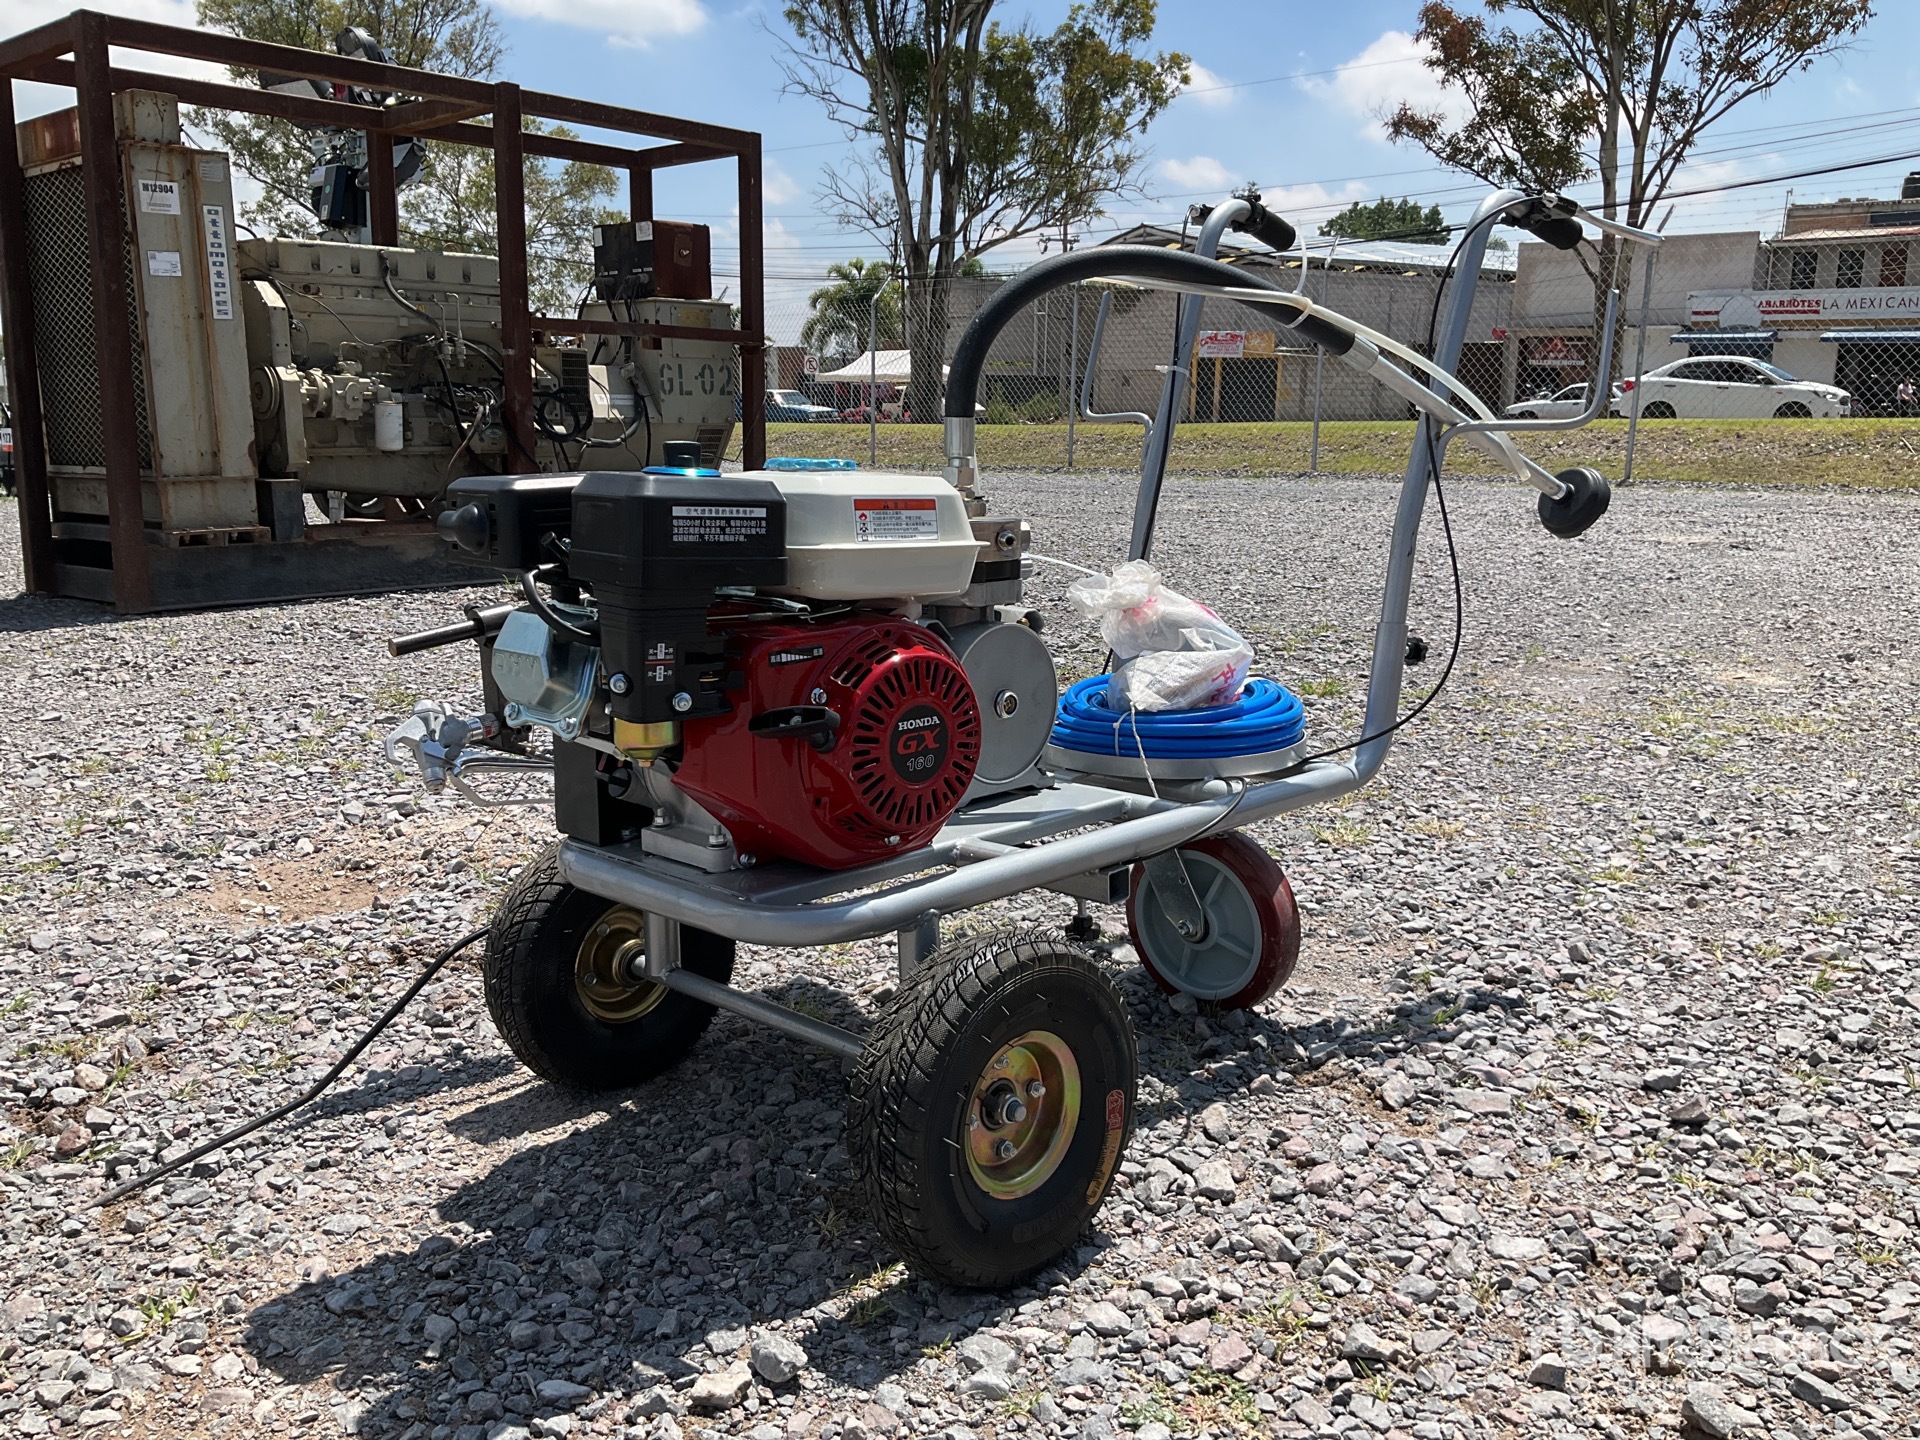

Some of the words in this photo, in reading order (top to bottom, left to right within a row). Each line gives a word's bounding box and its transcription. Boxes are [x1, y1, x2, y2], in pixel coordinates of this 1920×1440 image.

[206, 208, 229, 316] ottomotores
[1822, 298, 1839, 310] LA
[898, 716, 940, 731] HONDA
[898, 728, 940, 754] GX
[907, 755, 934, 771] 160
